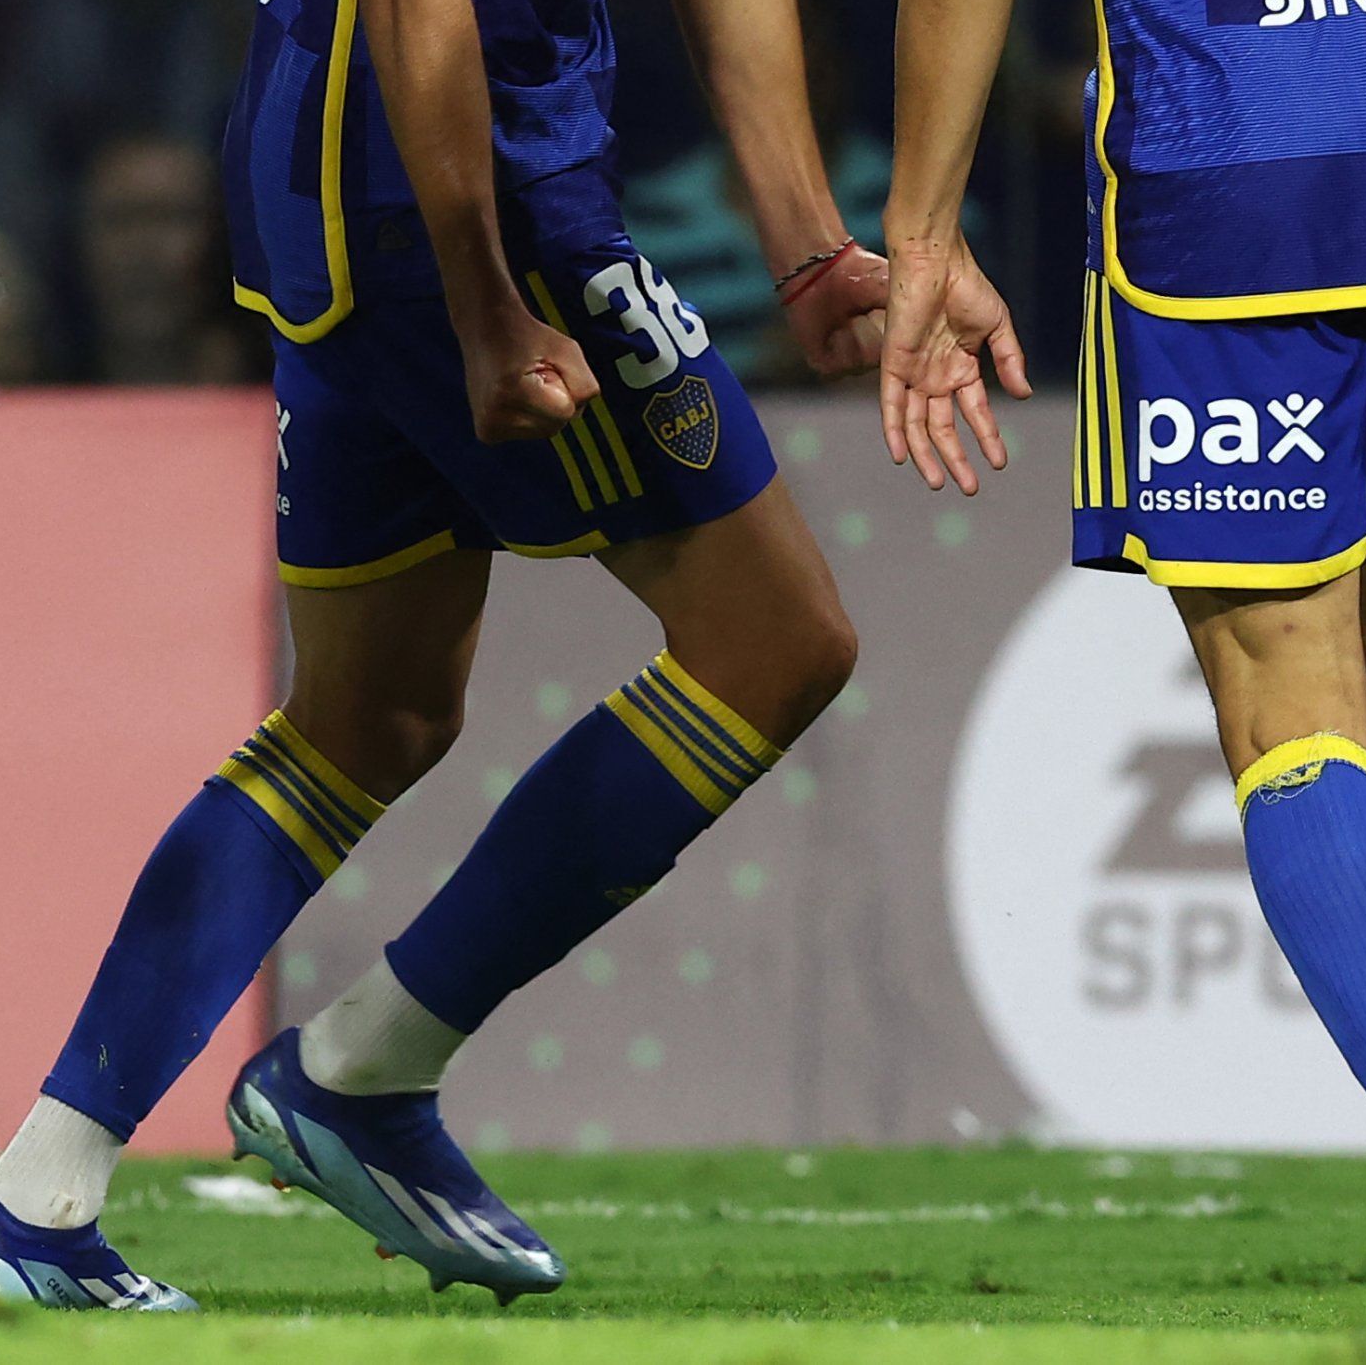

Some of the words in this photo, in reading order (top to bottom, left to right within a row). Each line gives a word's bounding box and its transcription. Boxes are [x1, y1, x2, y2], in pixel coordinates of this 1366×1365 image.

[583, 253, 711, 390] 38
[660, 401, 709, 440] CABJ
[1138, 392, 1326, 483] pax
[1138, 481, 1327, 512] assistance
